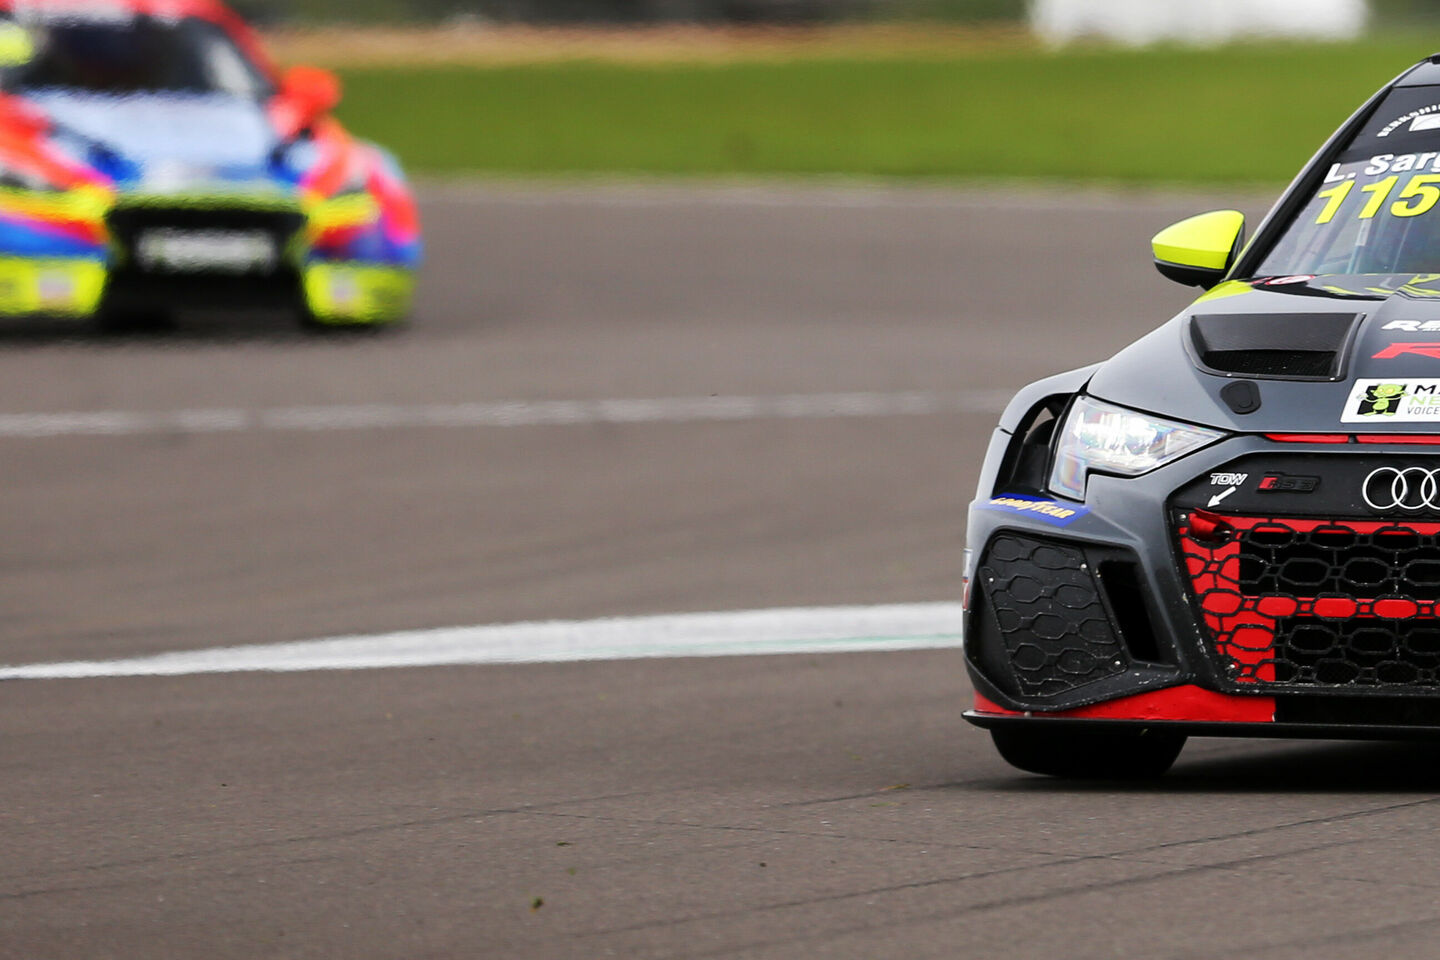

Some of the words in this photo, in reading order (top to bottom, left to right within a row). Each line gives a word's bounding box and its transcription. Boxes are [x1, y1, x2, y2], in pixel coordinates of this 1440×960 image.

[1323, 163, 1356, 183] L.
[1406, 406, 1440, 415] VOICE
[1210, 473, 1249, 486] TOW
